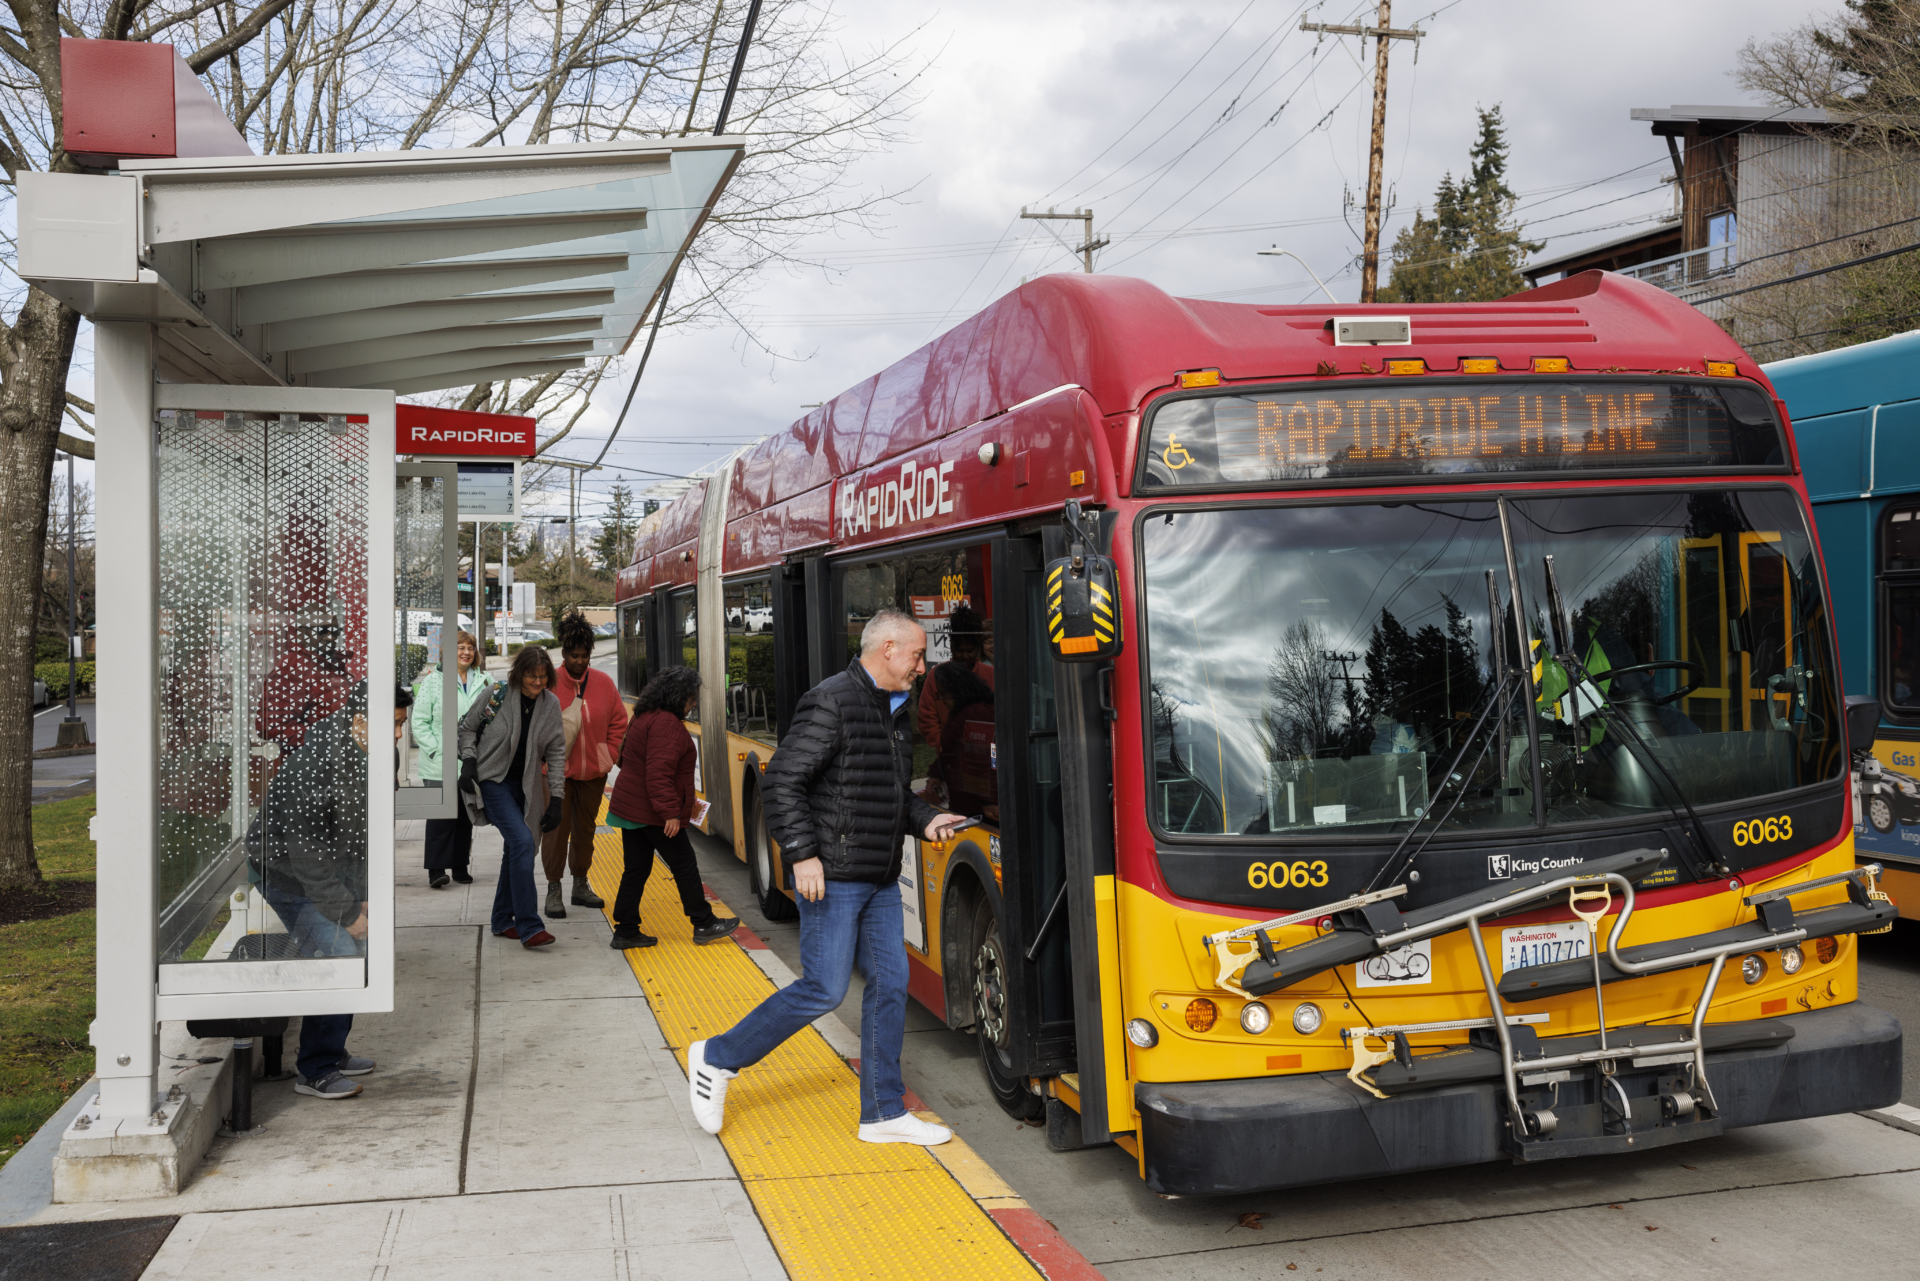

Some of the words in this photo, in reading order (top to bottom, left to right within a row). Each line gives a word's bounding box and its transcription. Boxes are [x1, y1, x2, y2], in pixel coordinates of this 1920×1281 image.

[411, 427, 526, 443] RAPIDRIDE
[1257, 396, 1502, 461] RAPIDRIDE
[1519, 395, 1544, 453] H
[1560, 393, 1656, 452] LINE
[508, 476, 513, 484] 3
[841, 460, 954, 538] RAPIDRIDE
[942, 574, 963, 602] 6063
[1892, 751, 1916, 766] Gas
[1733, 815, 1793, 846] 6063
[1901, 828, 1920, 846] king
[1512, 859, 1540, 873] King
[1541, 856, 1584, 869] County
[1248, 860, 1329, 889] 6063
[1509, 932, 1557, 943] WASHINGTON
